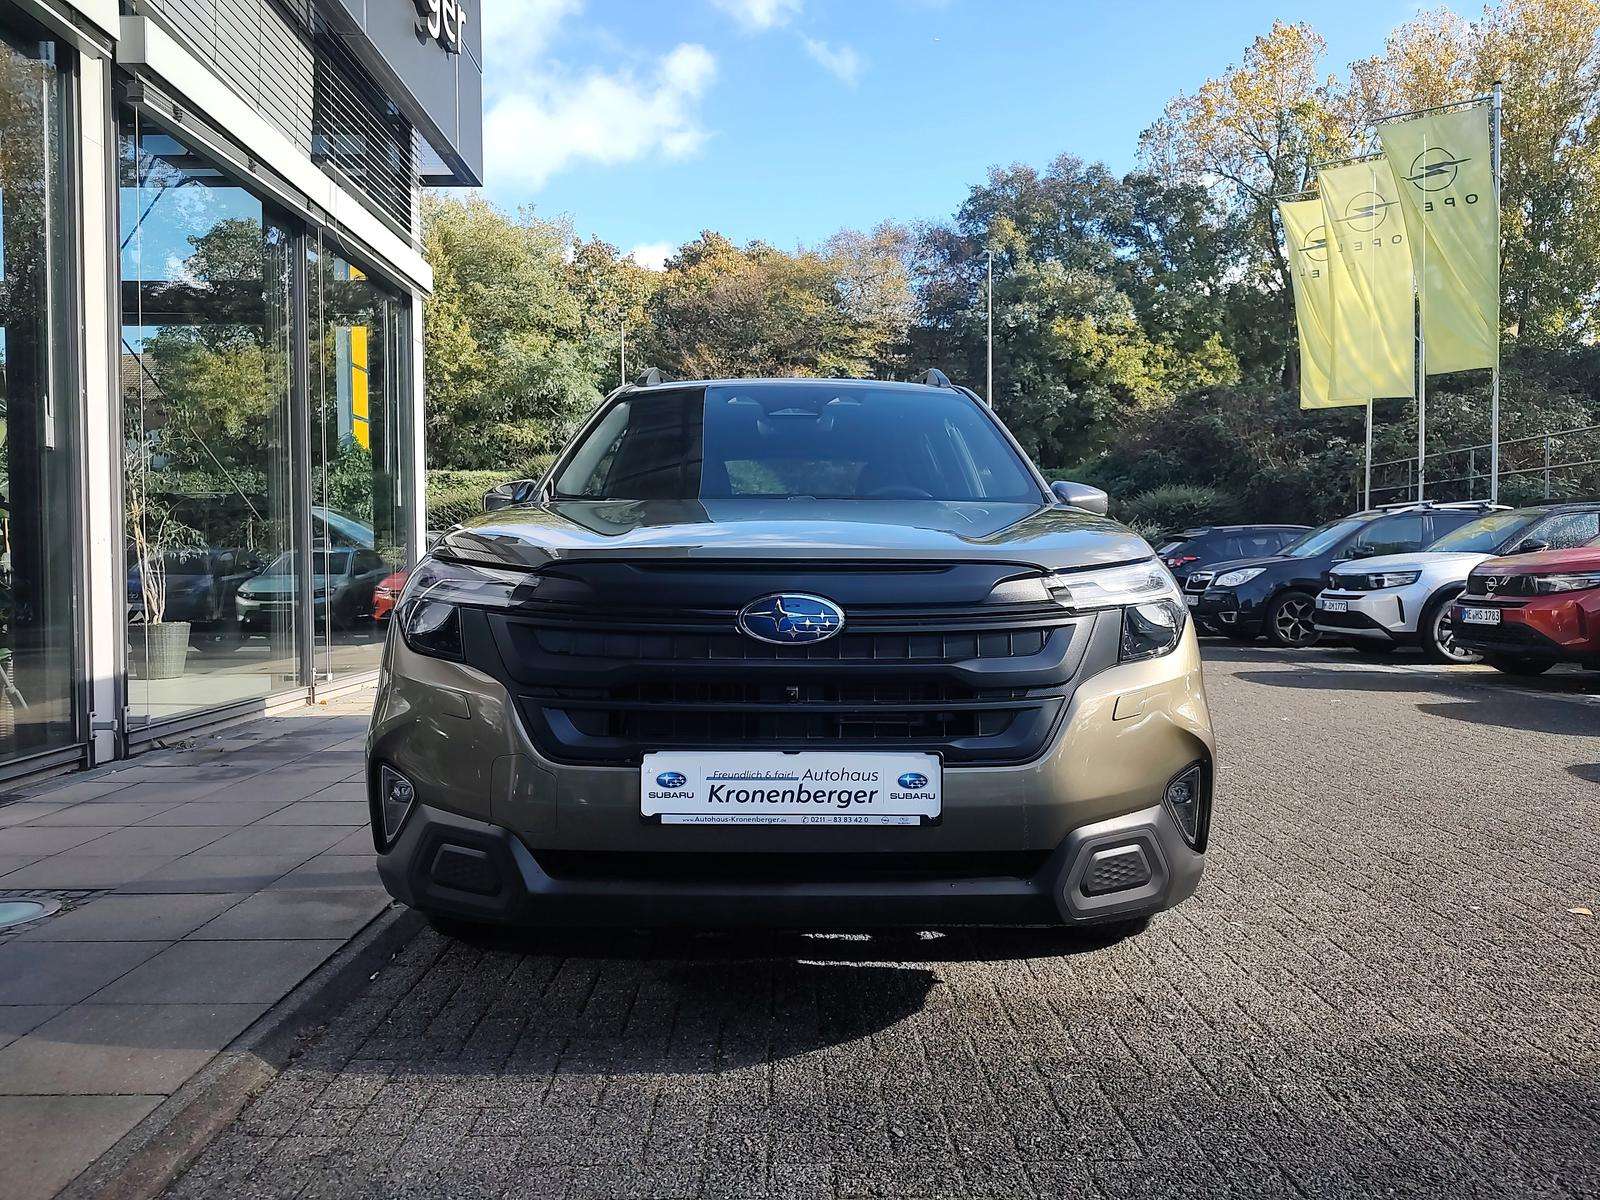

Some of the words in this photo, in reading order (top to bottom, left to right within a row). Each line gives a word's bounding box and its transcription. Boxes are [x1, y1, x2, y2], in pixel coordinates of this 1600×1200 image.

[1484, 610, 1500, 621] 1783
[712, 770, 763, 780] Freundlich
[764, 771, 773, 779] &
[774, 770, 795, 780] fair!
[801, 768, 879, 782] Autohaus
[648, 791, 695, 799] SUBARU
[707, 783, 879, 809] Kronenberger
[889, 792, 936, 800] SUBARU
